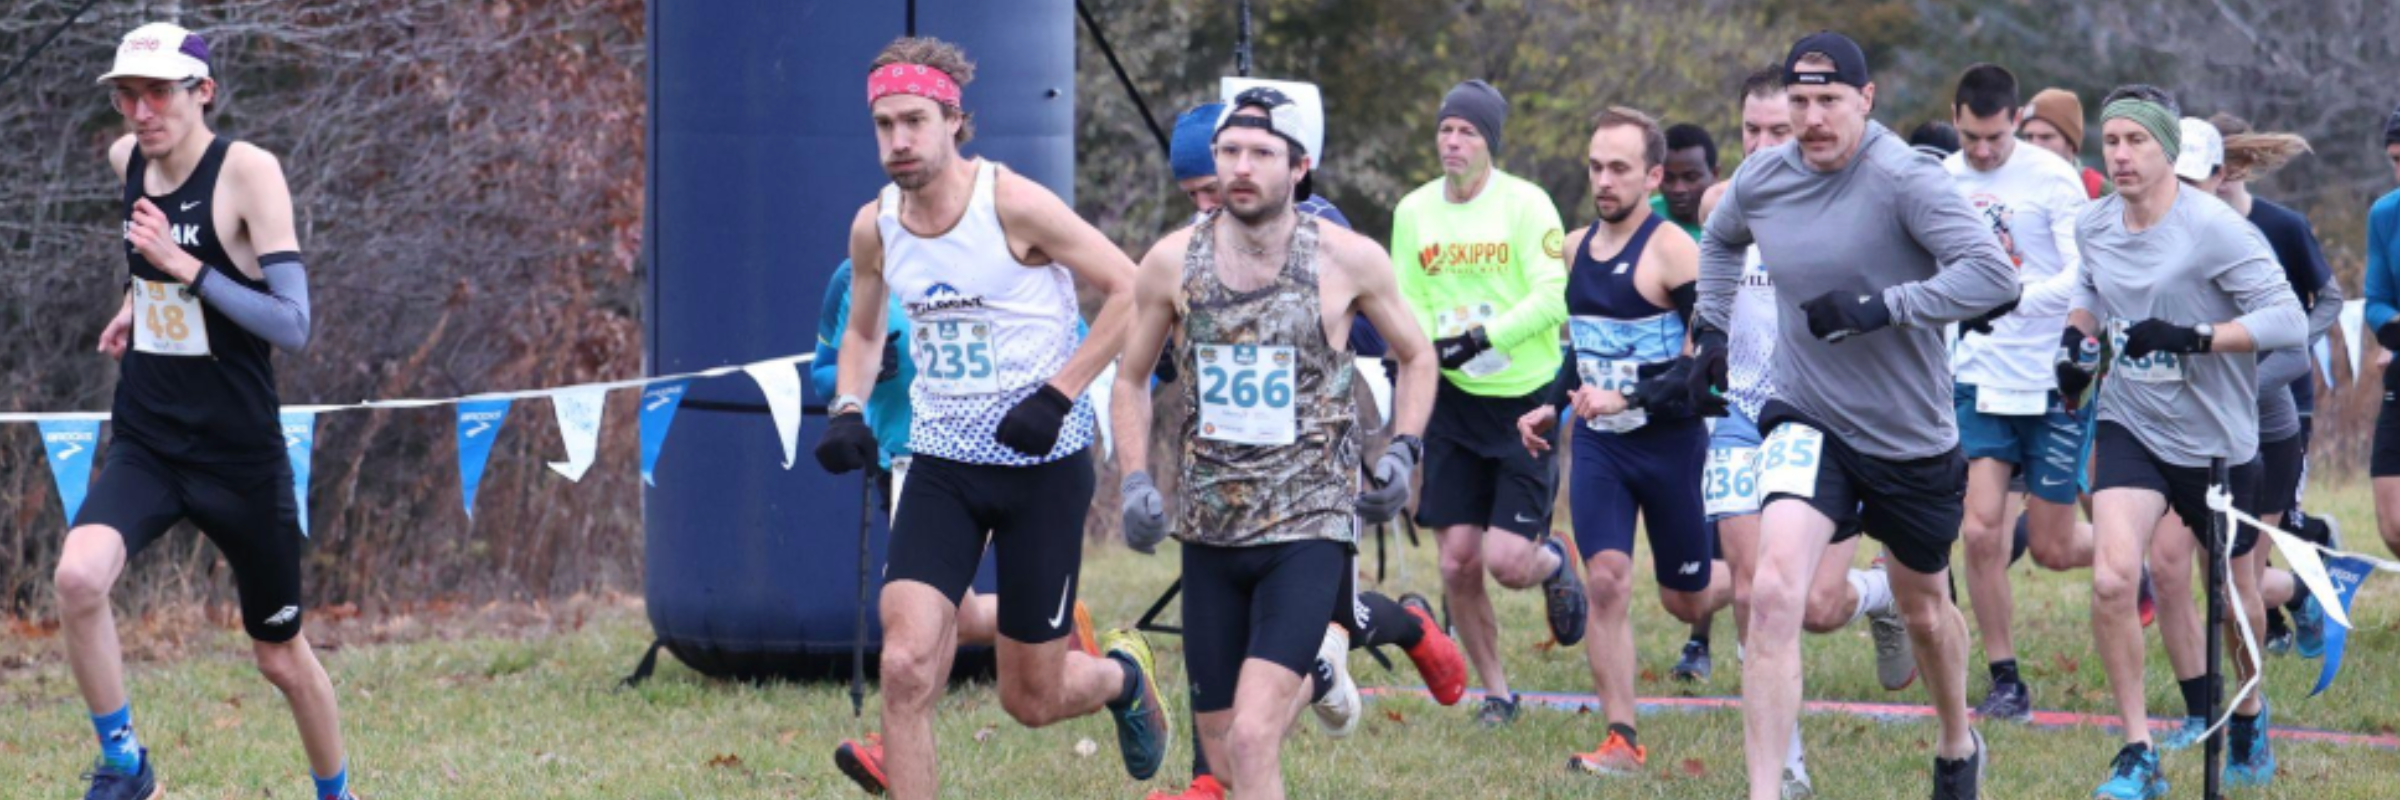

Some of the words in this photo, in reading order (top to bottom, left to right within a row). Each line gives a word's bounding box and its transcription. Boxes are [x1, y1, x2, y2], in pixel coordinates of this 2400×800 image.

[1448, 242, 1509, 266] SKIPPO
[146, 304, 189, 341] 48
[921, 341, 992, 380] 235
[1202, 365, 1291, 408] 266
[1704, 466, 1755, 501] 236
